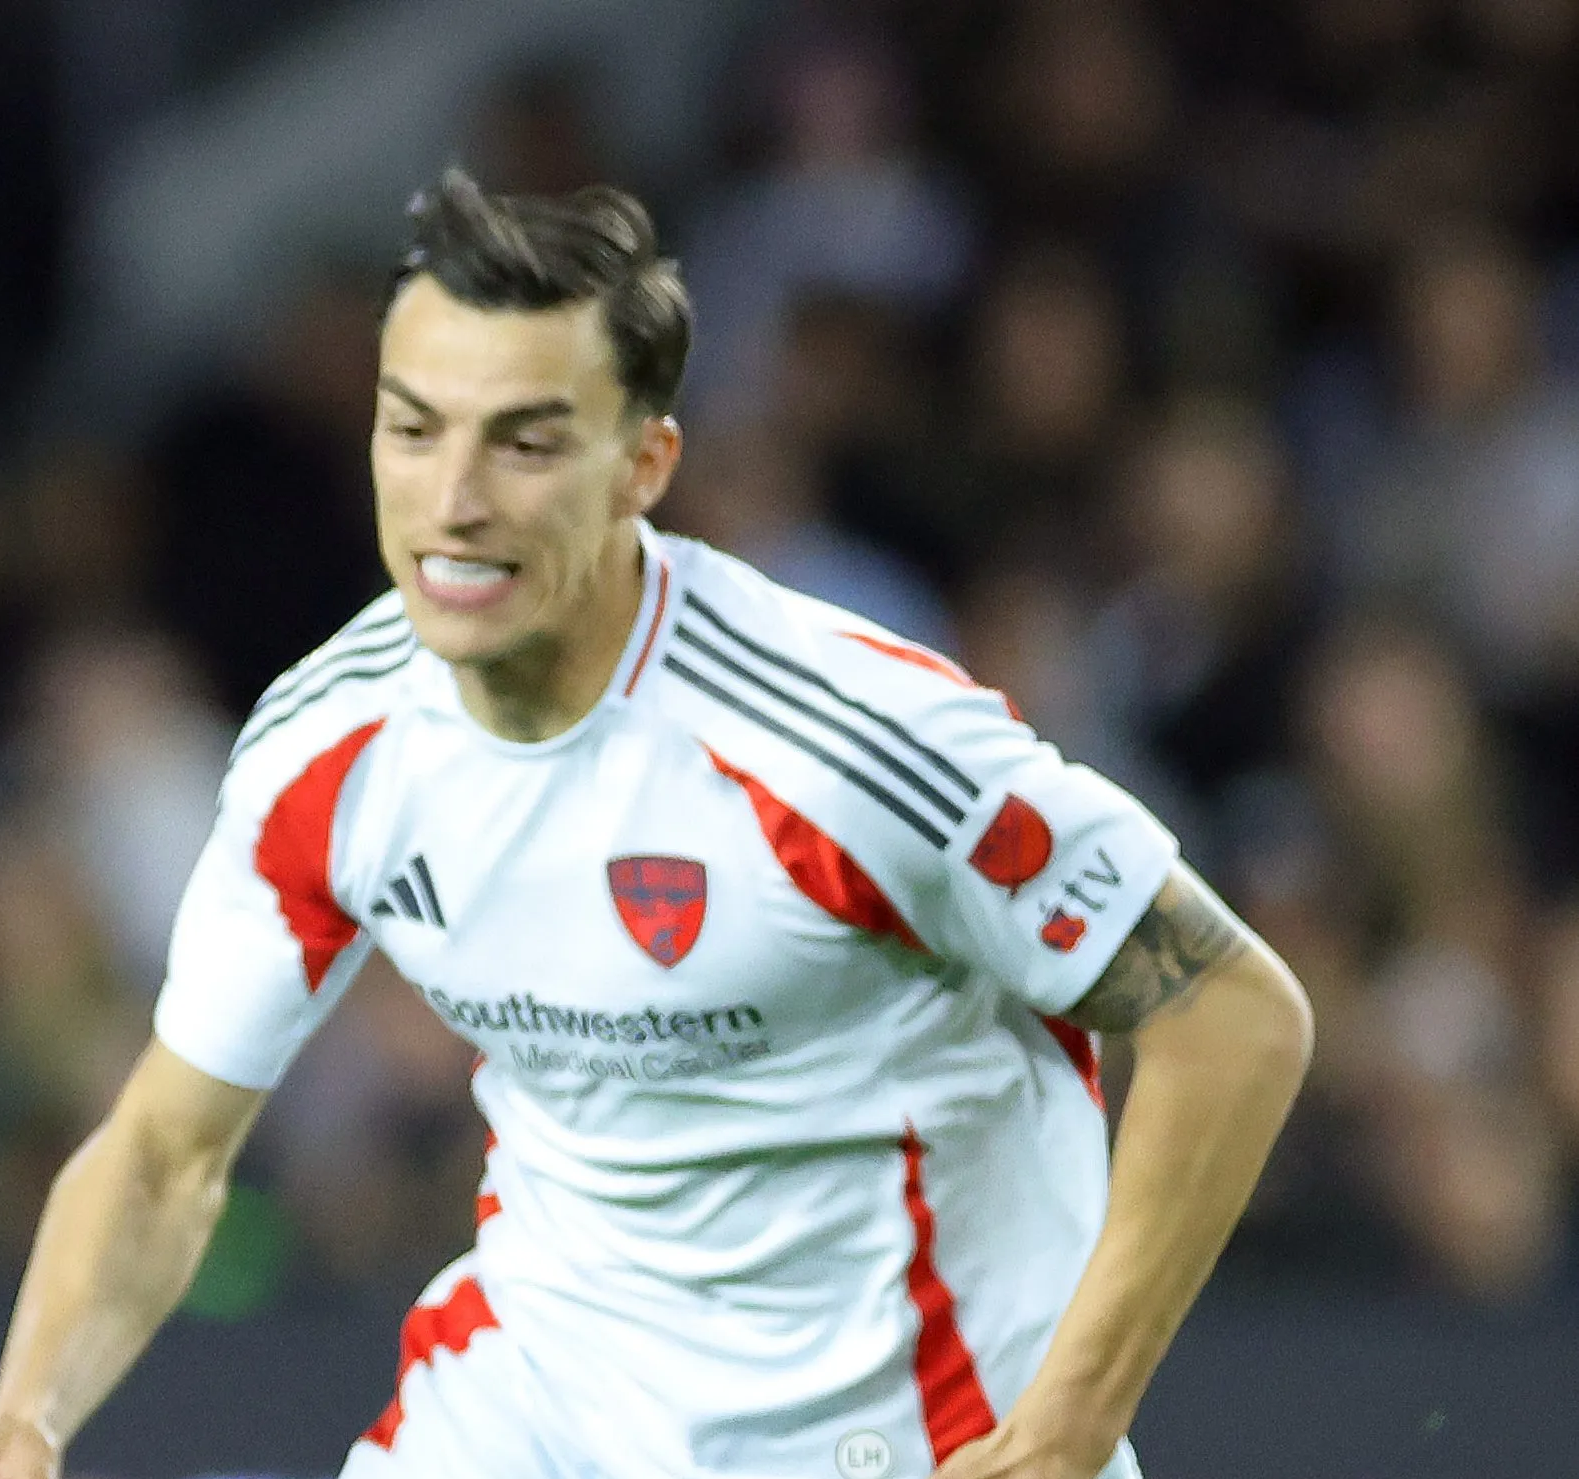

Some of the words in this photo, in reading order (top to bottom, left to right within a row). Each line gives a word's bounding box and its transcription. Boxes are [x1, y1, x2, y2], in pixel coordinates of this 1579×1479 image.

[1060, 847, 1122, 913] tv
[429, 988, 764, 1046] Southwestern
[847, 1446, 884, 1469] LH
